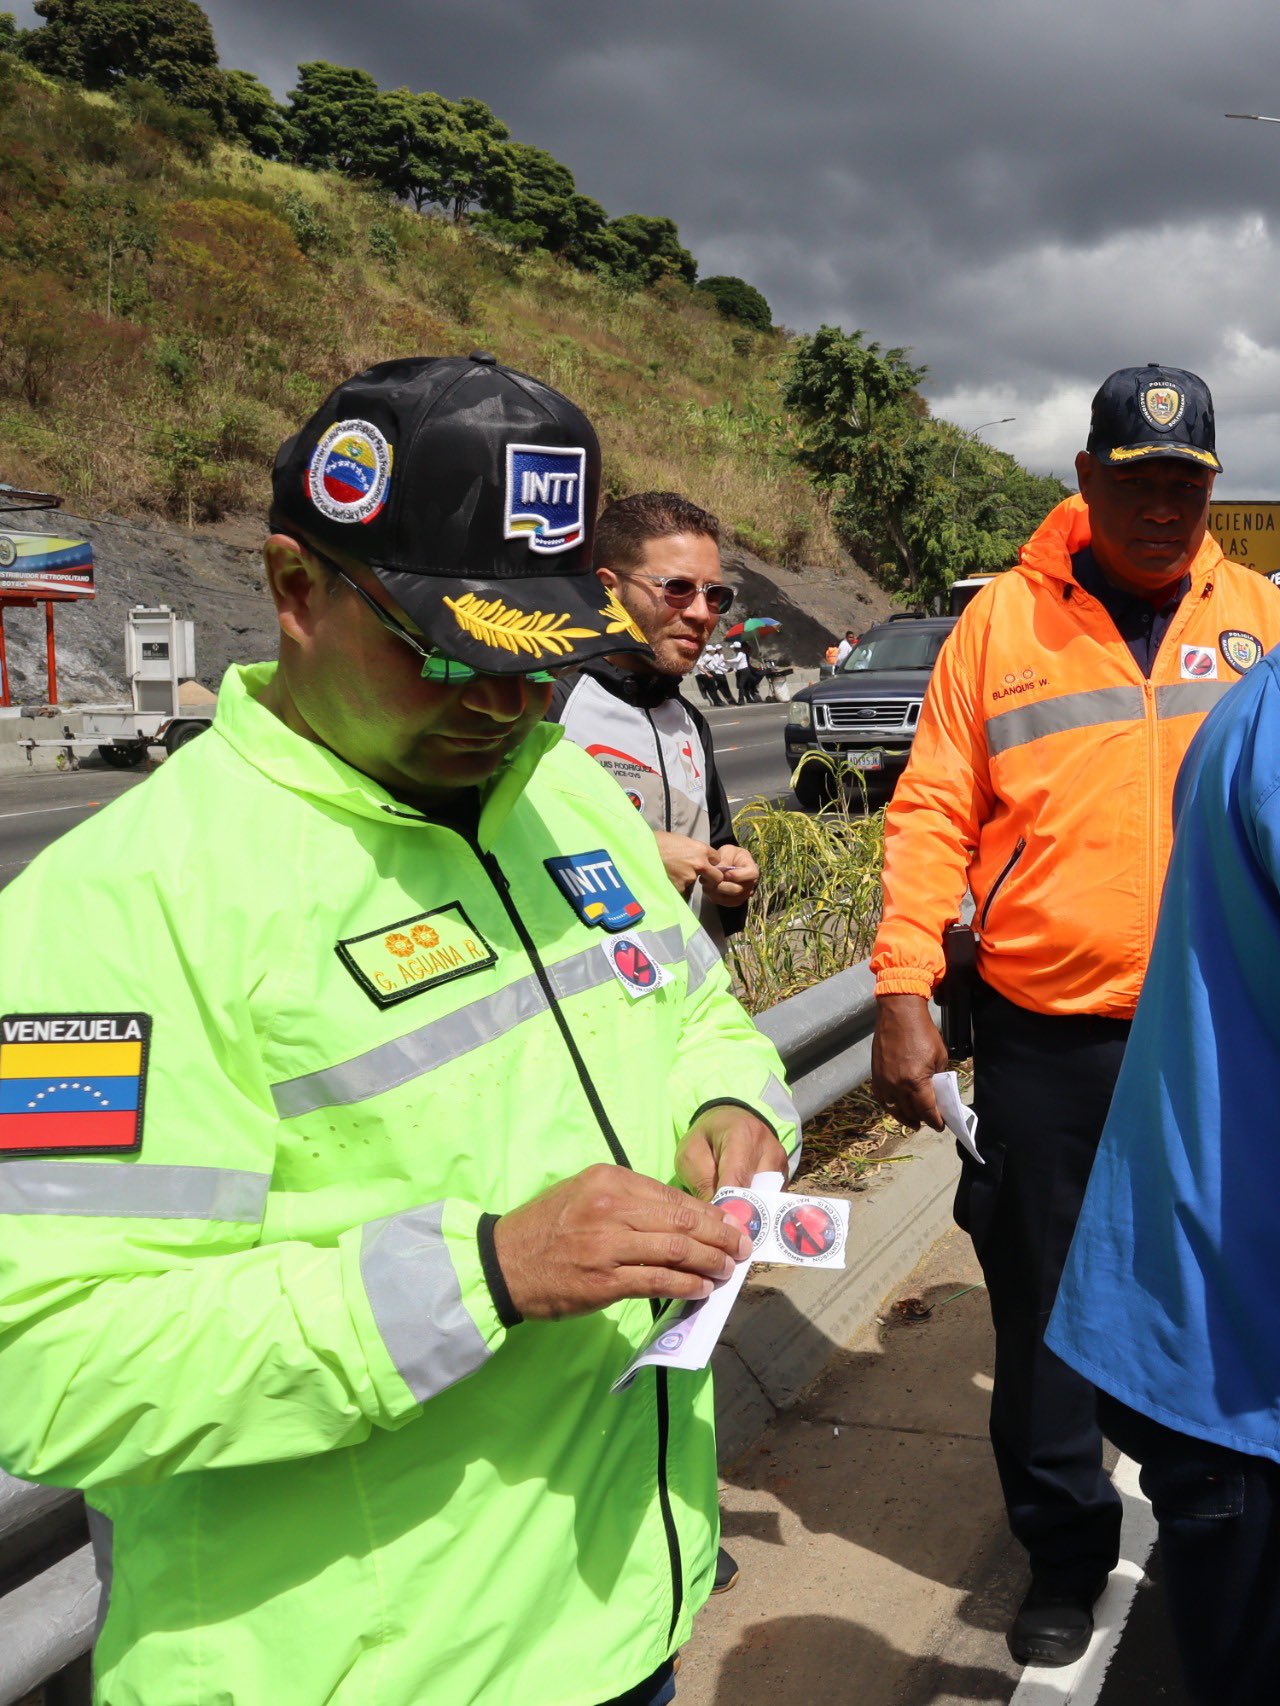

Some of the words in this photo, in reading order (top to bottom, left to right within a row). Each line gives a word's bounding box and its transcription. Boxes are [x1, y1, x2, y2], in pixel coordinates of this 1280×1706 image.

[1140, 392, 1153, 422] NACIONAL
[521, 470, 578, 505] INTT
[1220, 538, 1248, 556] LAS
[40, 573, 90, 582] METROPOLITANO
[992, 682, 1035, 700] BLANQUIS
[1038, 679, 1050, 687] W.
[613, 762, 652, 773] RODRIGUEZ
[558, 860, 621, 897] INTT
[374, 971, 397, 991] G.
[397, 945, 466, 984] AGUANA
[463, 939, 486, 960] R.
[2, 1019, 142, 1041] VENEZUELA
[758, 1204, 768, 1221] USAS
[824, 1205, 834, 1214] NO
